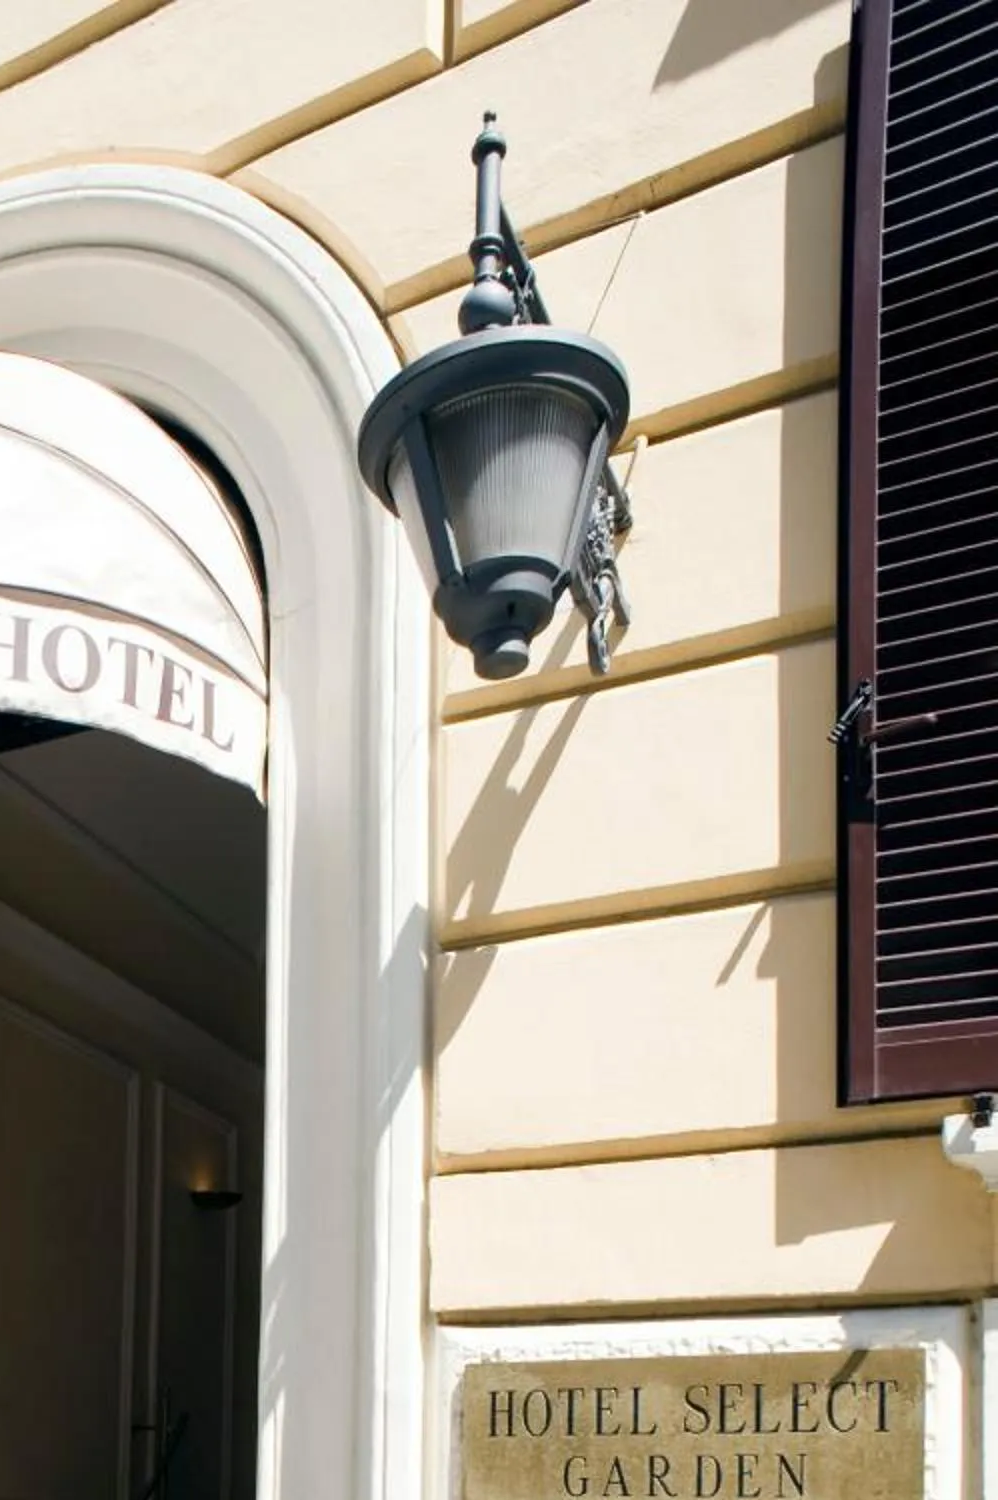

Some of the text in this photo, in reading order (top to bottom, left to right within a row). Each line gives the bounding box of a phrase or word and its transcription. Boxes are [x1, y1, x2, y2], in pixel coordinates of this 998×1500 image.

[487, 1378, 899, 1438] HOTEL SELECT
[563, 1453, 808, 1499] GARDEN
